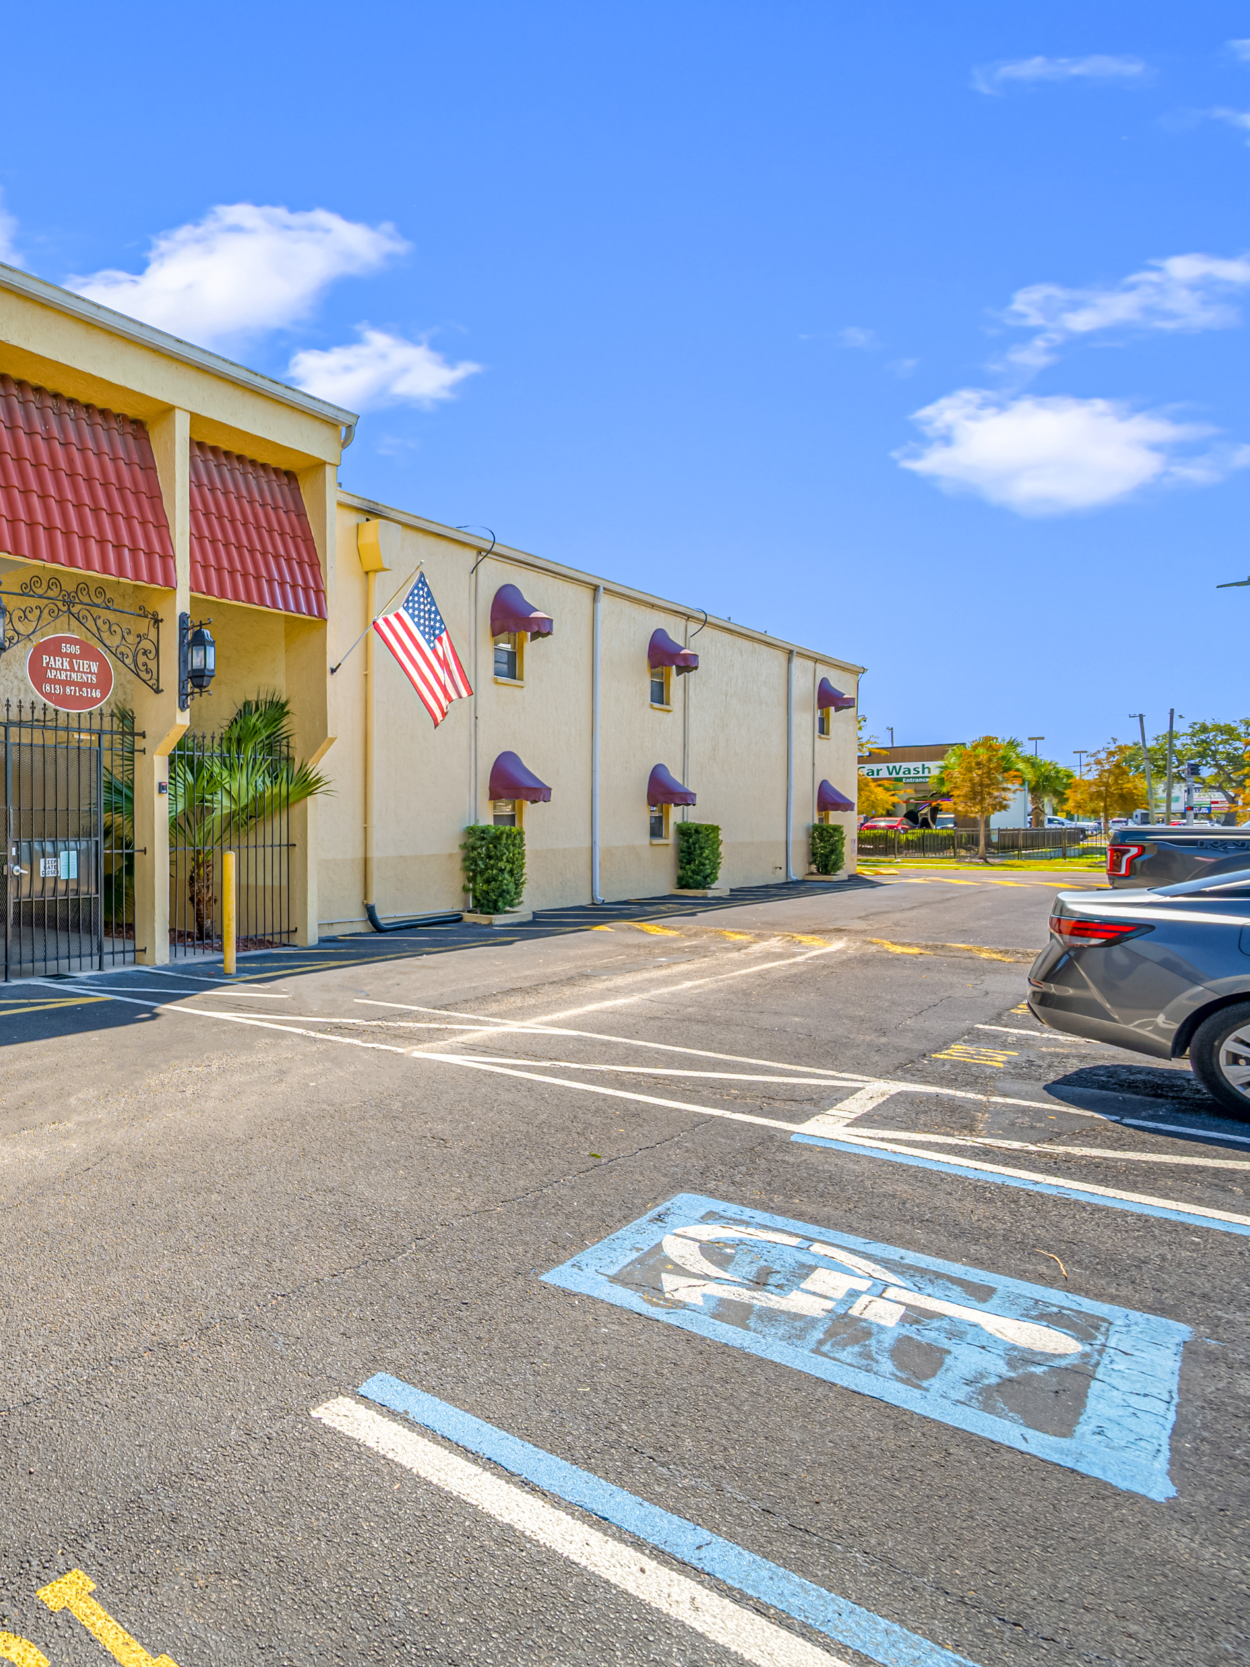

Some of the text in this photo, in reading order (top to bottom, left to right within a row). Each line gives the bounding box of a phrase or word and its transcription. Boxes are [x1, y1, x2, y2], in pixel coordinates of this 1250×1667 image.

[61, 643, 80, 655] 5505
[42, 654, 99, 673] PARK VIEW
[46, 669, 97, 684] APARTMENTS
[42, 683, 101, 698] (813) 871-3146
[886, 763, 932, 776] Wash
